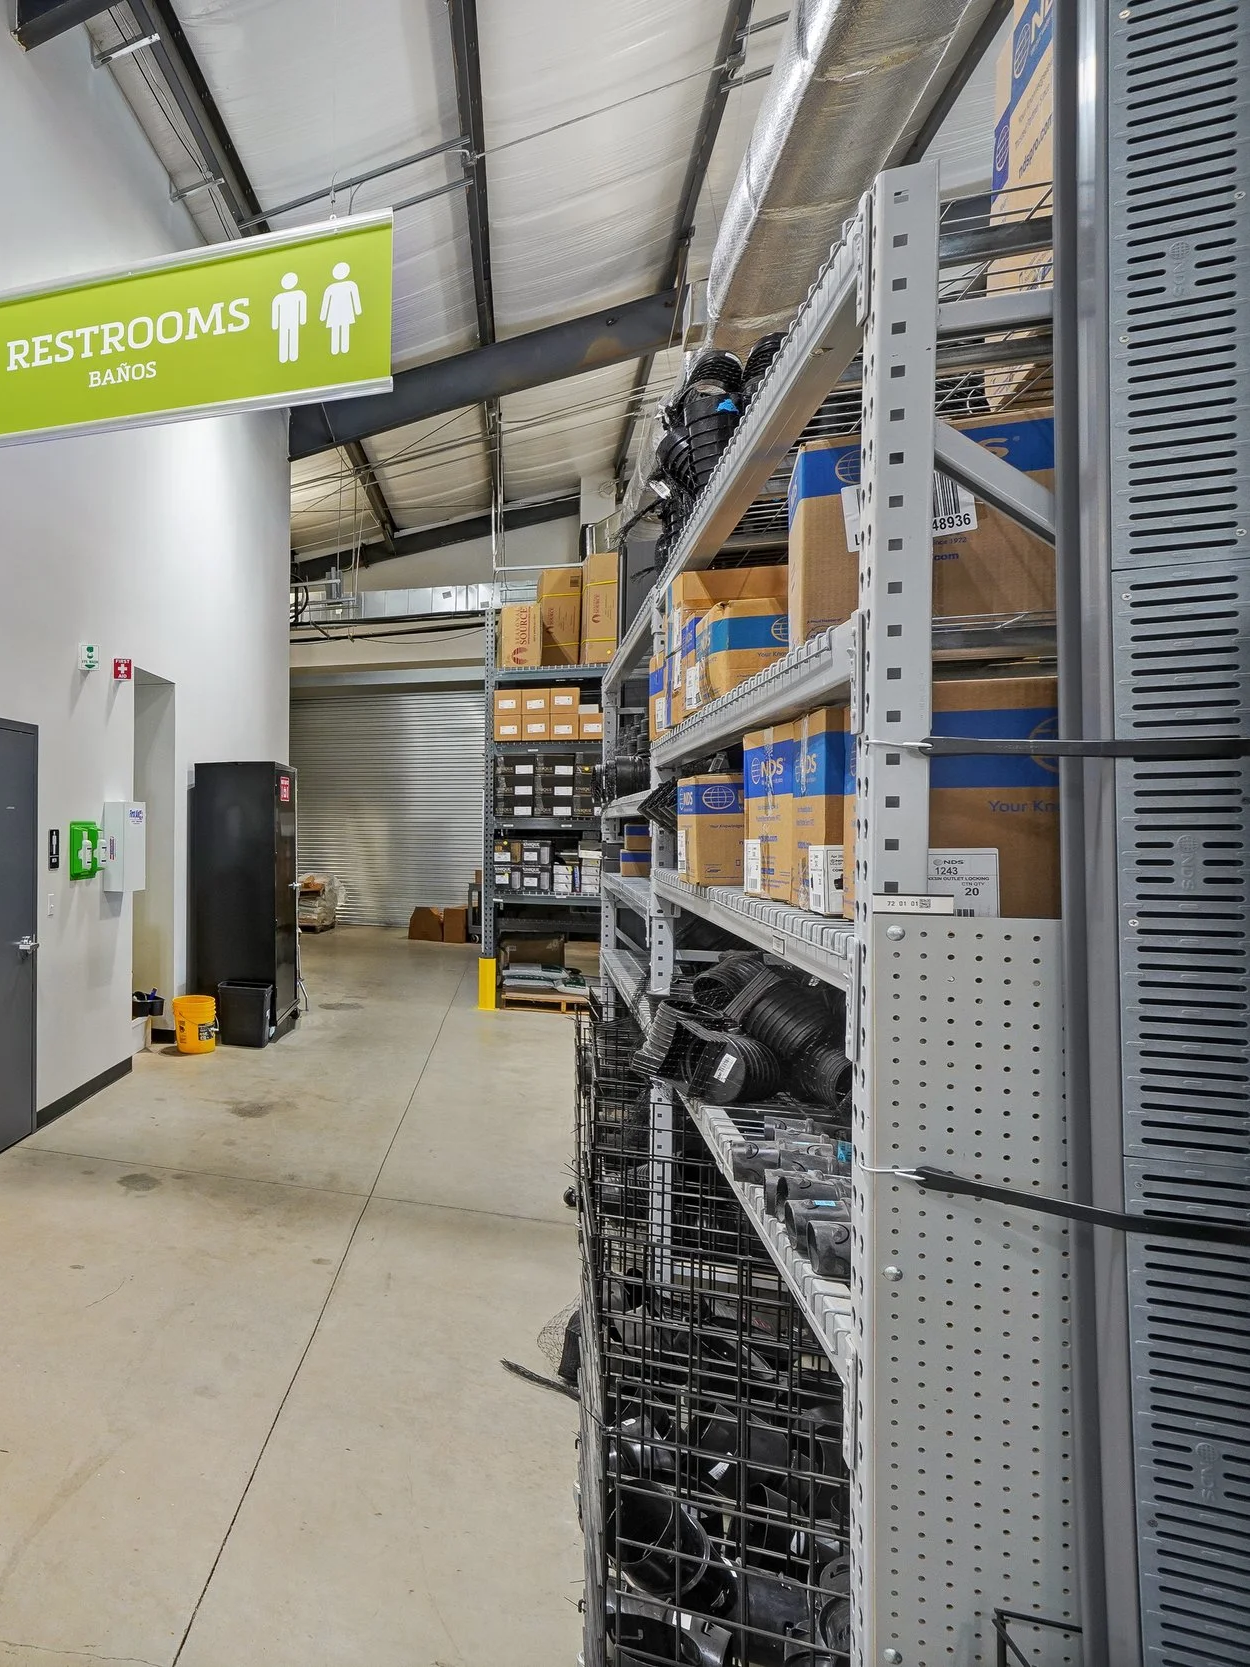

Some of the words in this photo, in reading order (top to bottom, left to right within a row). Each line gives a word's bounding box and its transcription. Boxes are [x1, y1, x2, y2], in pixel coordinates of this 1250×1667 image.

[6, 297, 251, 372] RESTROOMS
[88, 361, 157, 388] BAÑOS
[519, 607, 528, 645] SOURCE
[760, 757, 784, 776] NDS
[988, 800, 1027, 812] Your
[934, 867, 959, 875] 1243
[1180, 853, 1194, 891] NDS
[964, 887, 980, 896] 20
